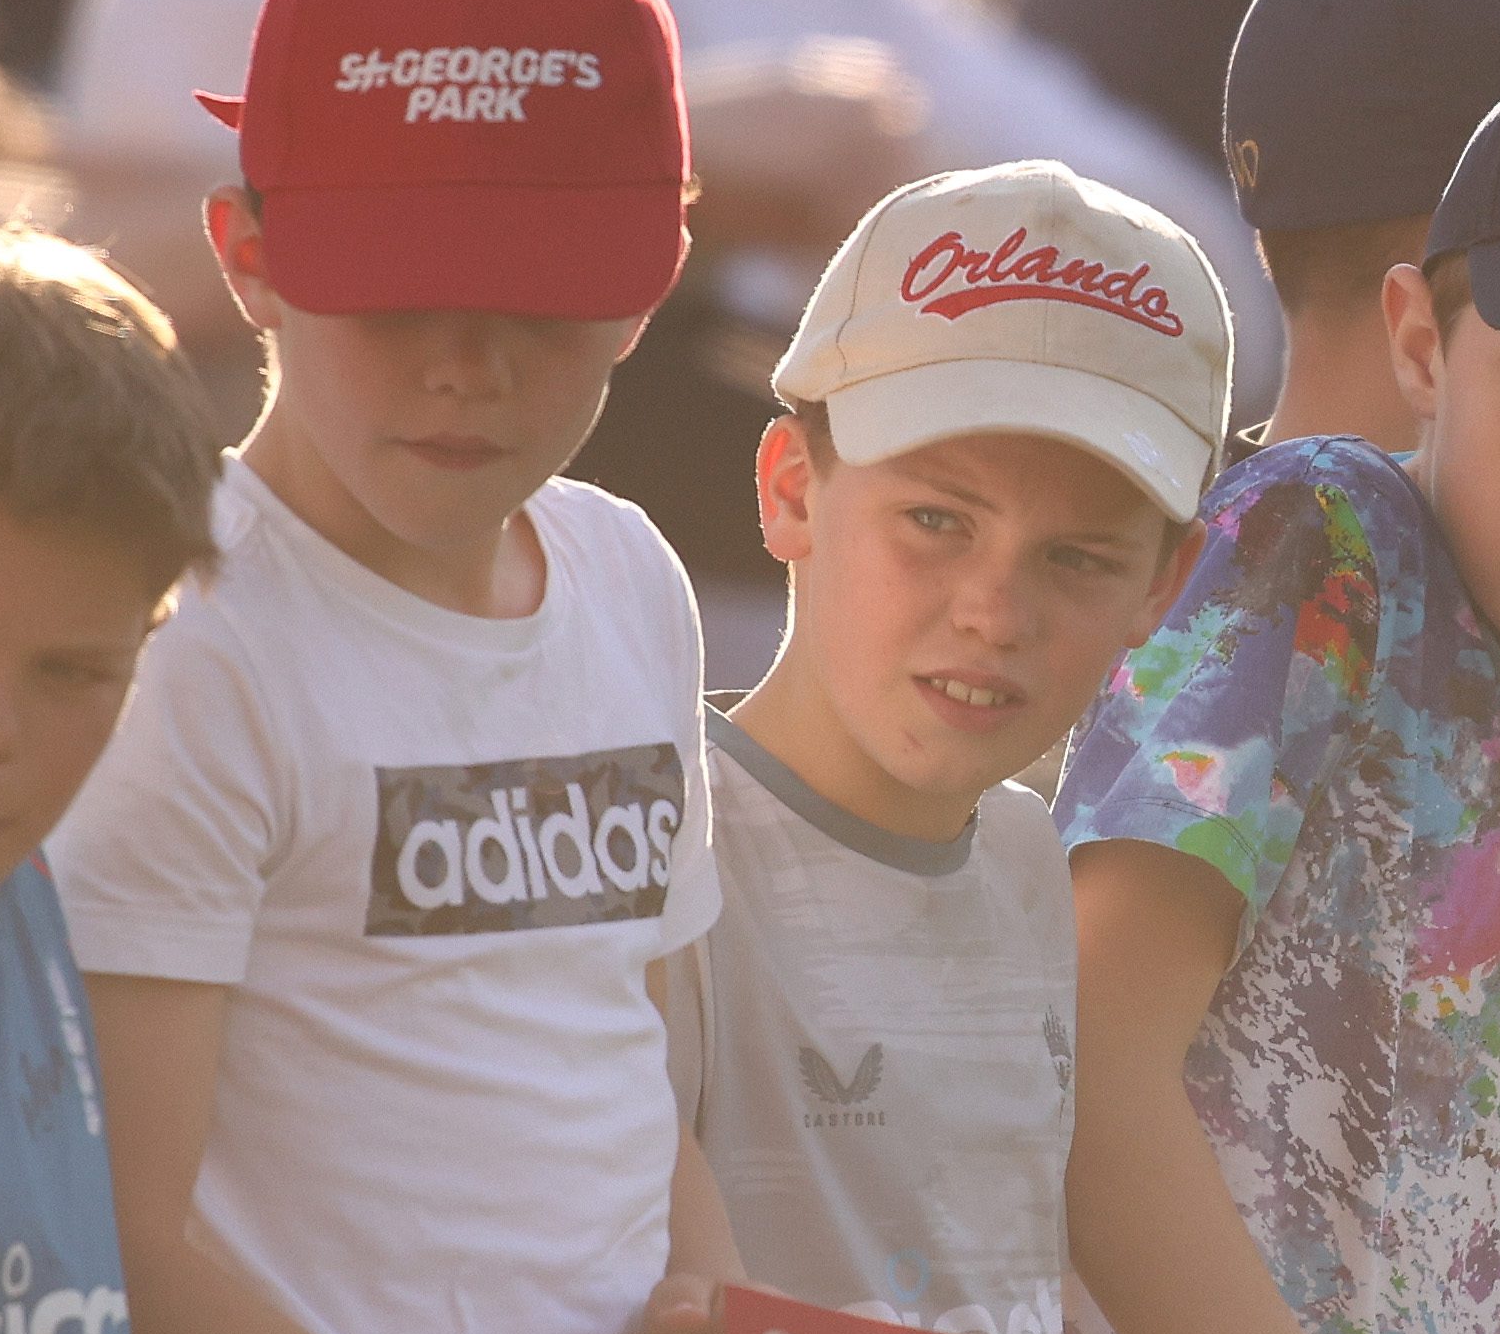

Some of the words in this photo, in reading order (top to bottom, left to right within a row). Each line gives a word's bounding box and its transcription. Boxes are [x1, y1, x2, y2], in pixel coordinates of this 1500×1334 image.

[404, 85, 529, 124] PARK
[901, 228, 1184, 329] Orlando
[397, 783, 678, 909] adidas
